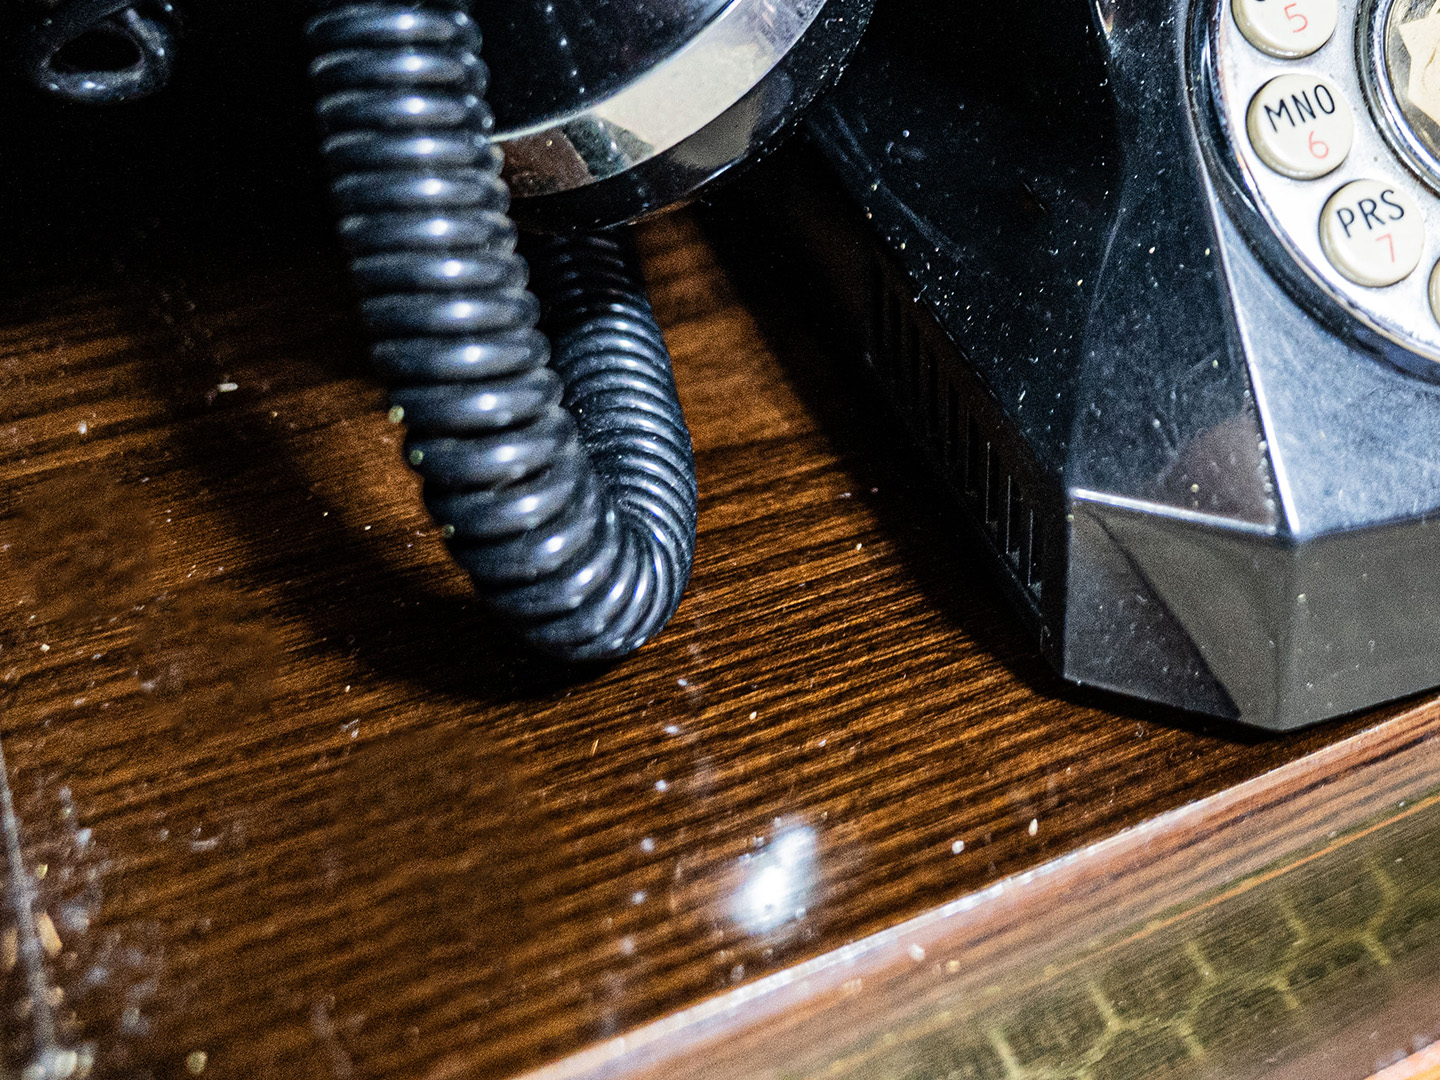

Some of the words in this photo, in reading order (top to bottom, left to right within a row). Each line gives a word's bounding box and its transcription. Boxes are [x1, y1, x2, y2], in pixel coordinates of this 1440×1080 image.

[1284, 3, 1308, 33] 5
[1264, 84, 1336, 132] MNO
[1308, 130, 1329, 159] 6
[1336, 189, 1405, 238] PRS
[1375, 233, 1395, 263] 7
